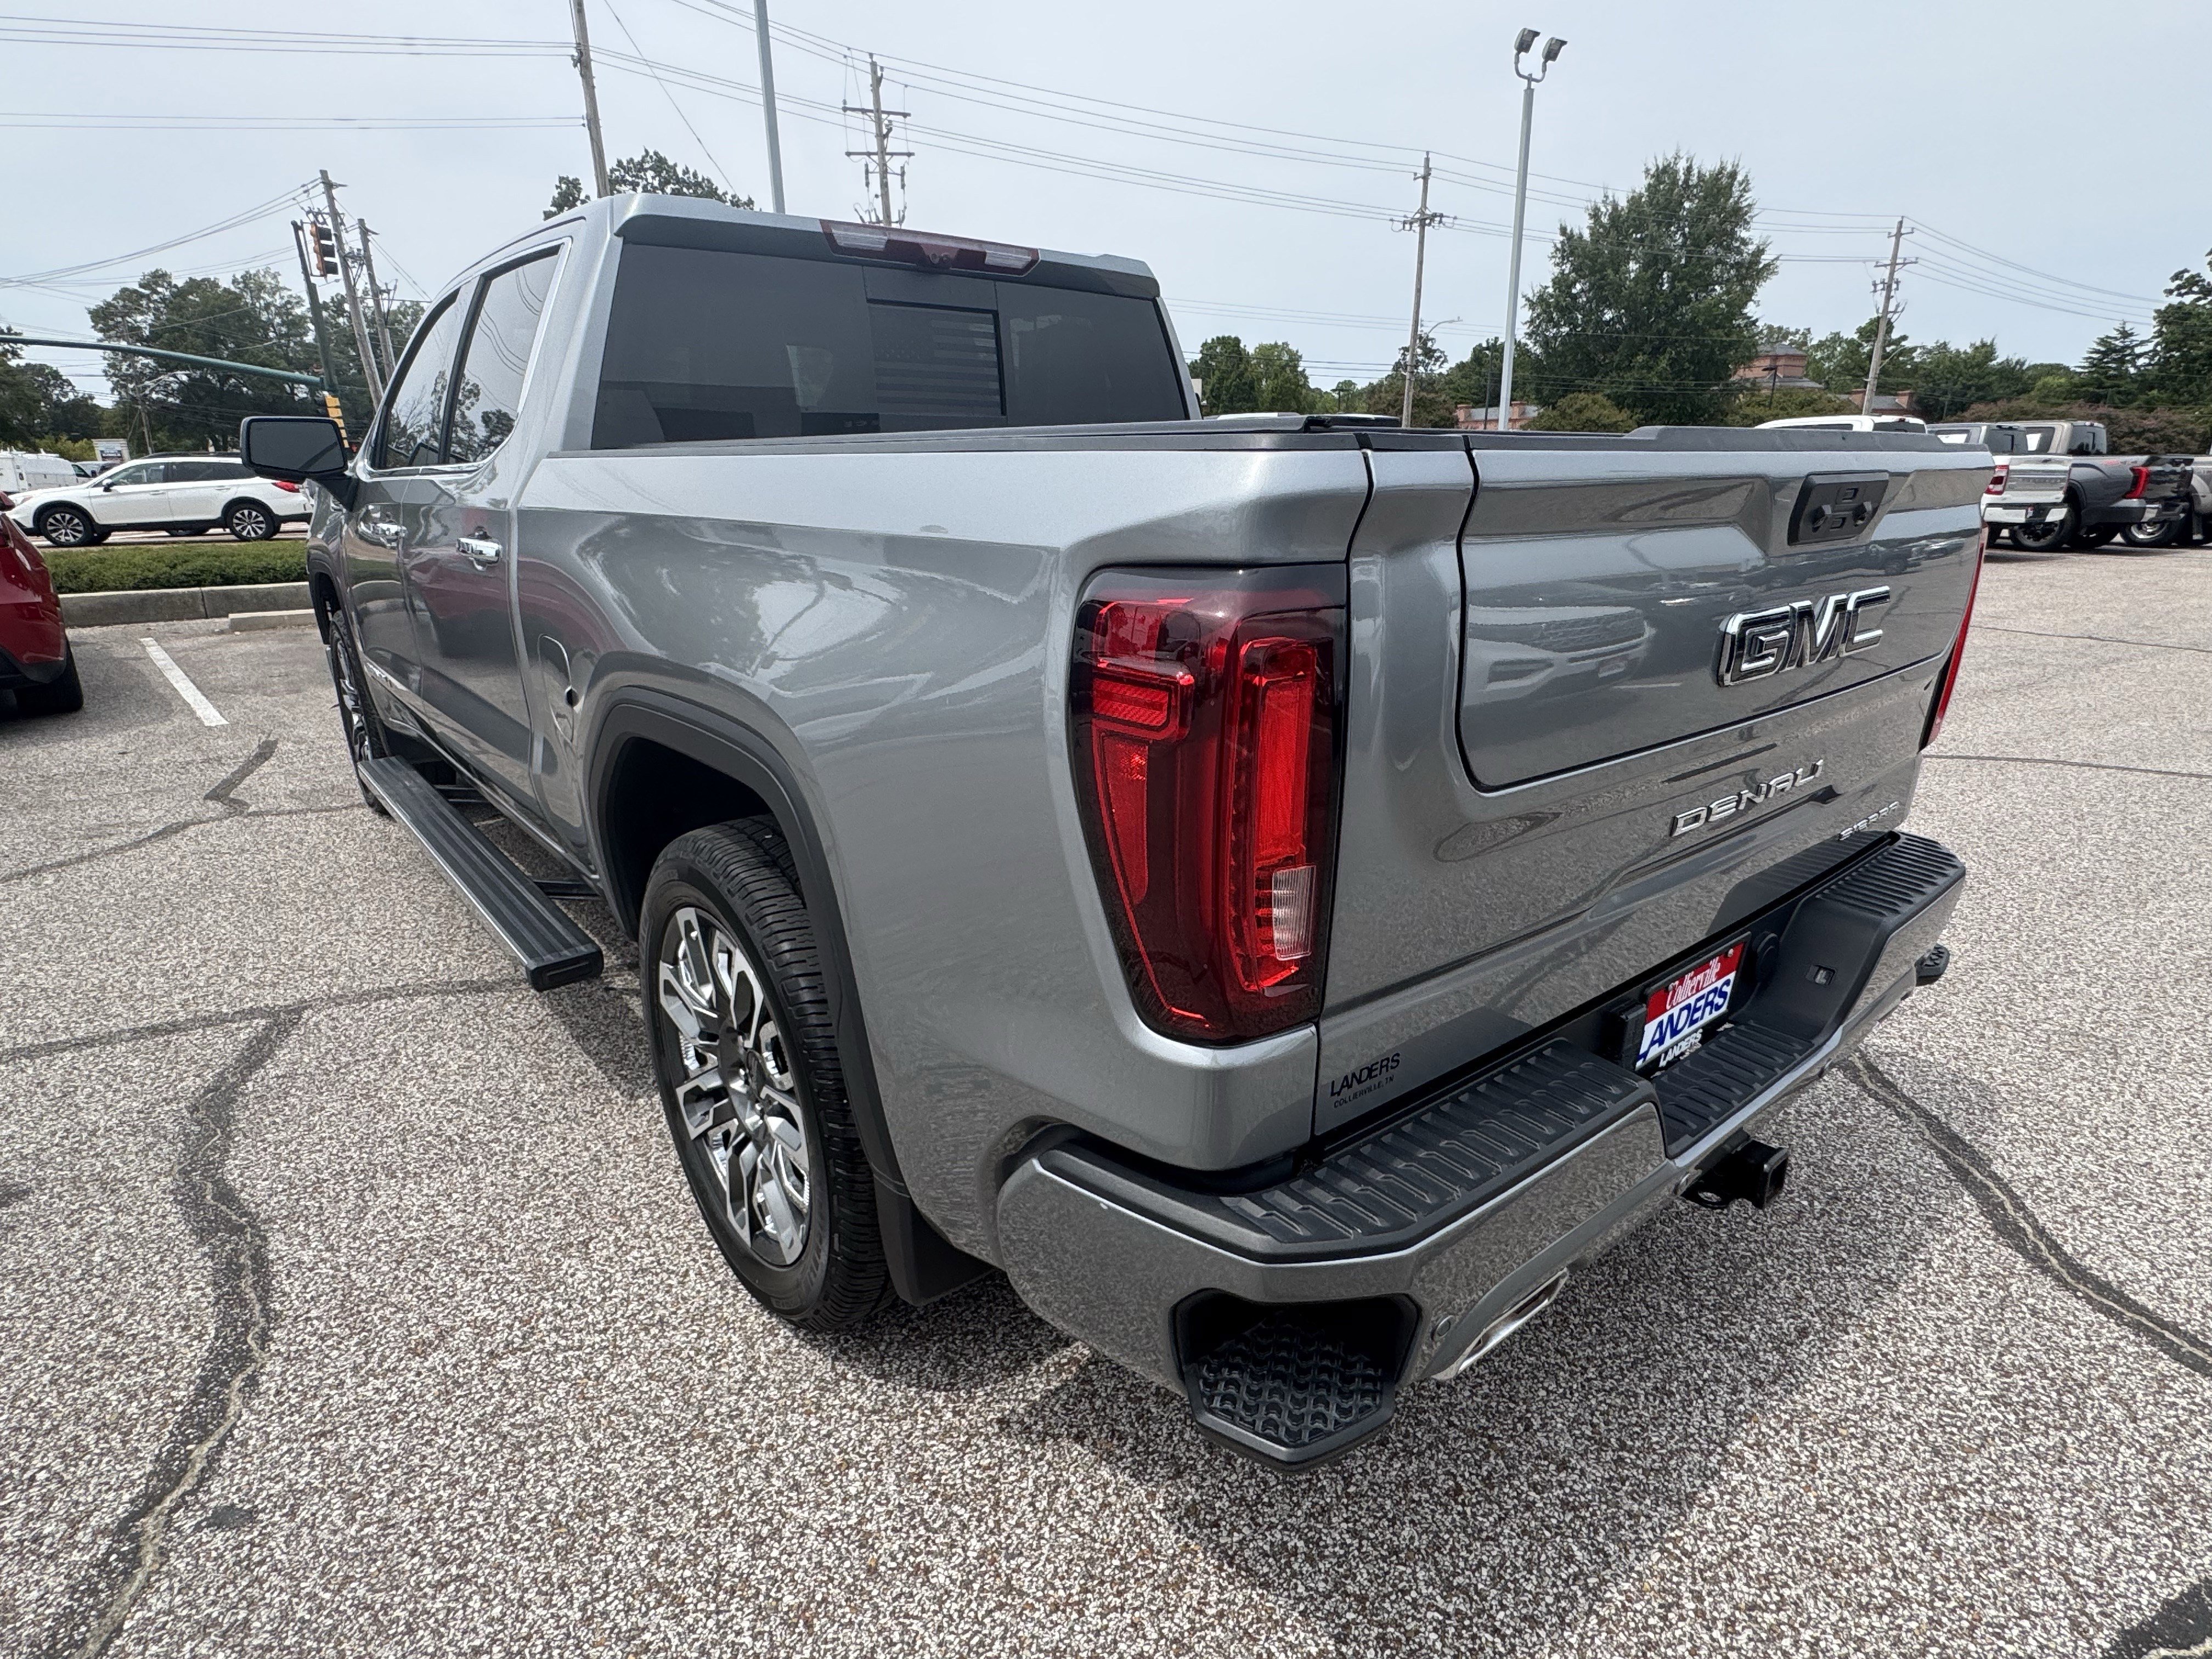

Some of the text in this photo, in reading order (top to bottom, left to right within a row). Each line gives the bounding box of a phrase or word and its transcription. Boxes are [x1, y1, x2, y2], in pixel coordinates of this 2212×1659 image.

[1718, 585, 1891, 687] GMC
[1669, 759, 1824, 837] DENALI
[1839, 801, 1899, 841] SIERRA
[1666, 956, 1721, 1010] Collierville
[1637, 978, 1731, 1063] ANDERS
[1658, 1028, 1703, 1068] LANDERS
[1330, 1052, 1401, 1097] LANDERS
[1385, 1074, 1395, 1085] TN
